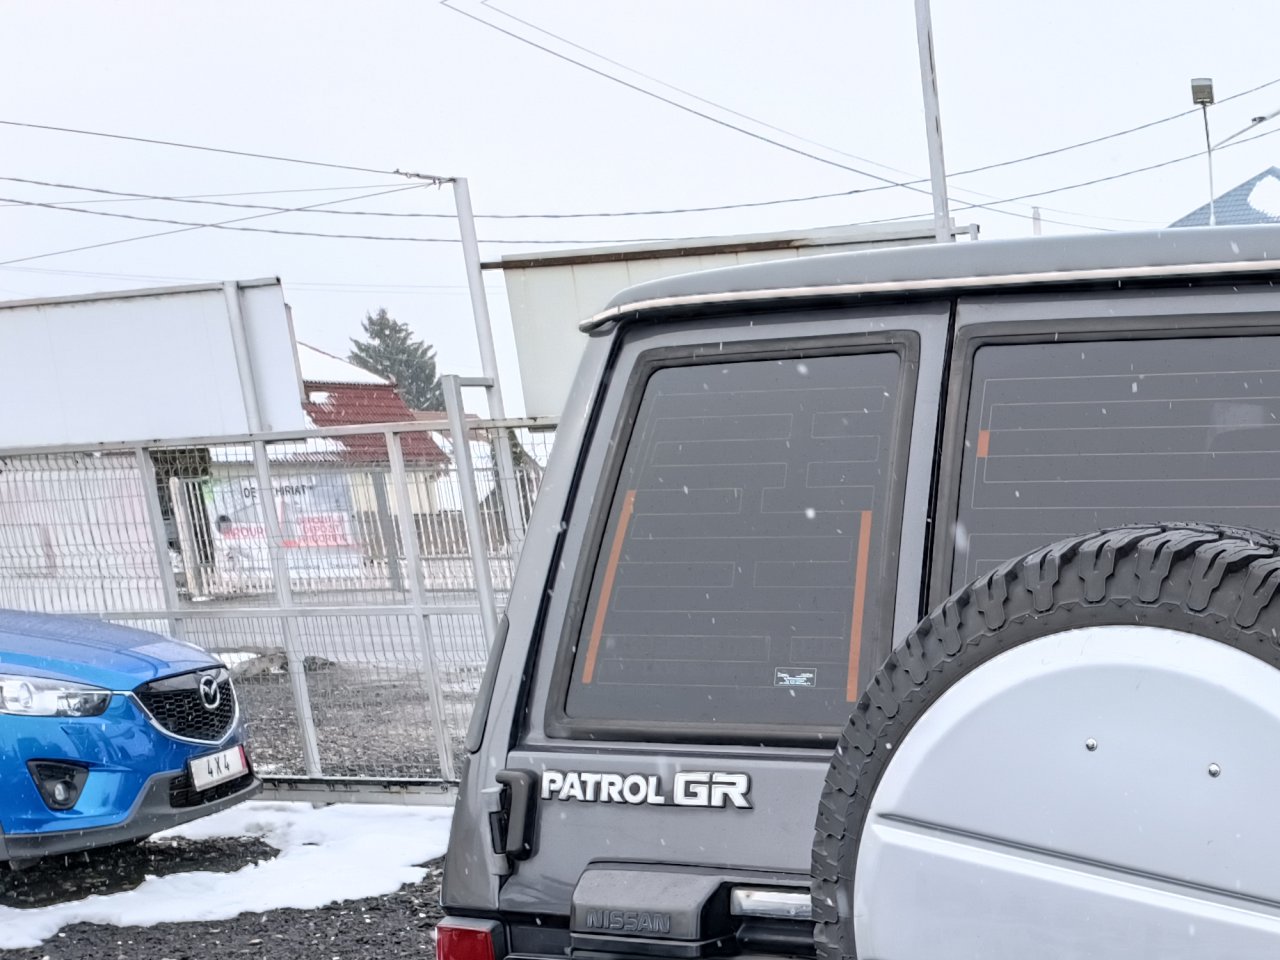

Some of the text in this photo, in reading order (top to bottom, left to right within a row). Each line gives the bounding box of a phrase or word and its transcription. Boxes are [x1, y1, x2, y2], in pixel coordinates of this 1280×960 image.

[540, 771, 752, 808] PATROL GR
[586, 910, 670, 933] NISSAN
